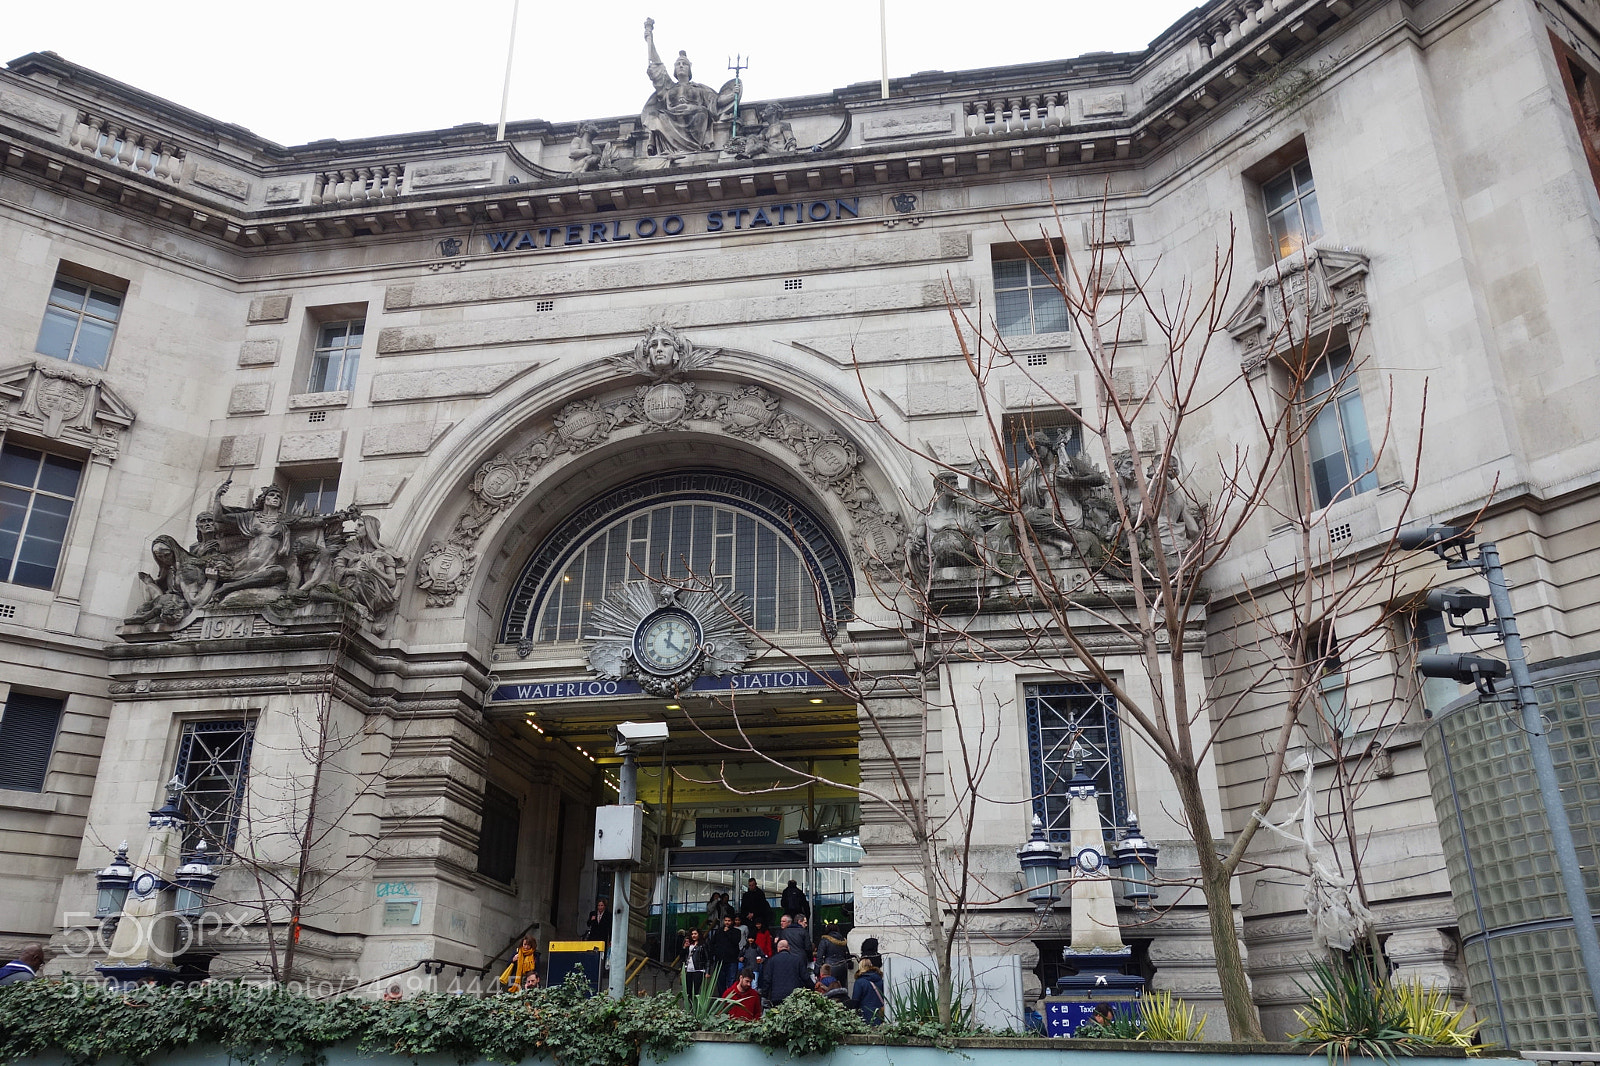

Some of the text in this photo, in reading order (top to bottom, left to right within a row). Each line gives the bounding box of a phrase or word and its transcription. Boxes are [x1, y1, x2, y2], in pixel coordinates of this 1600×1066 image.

[485, 215, 685, 253] WATERLOO
[707, 197, 860, 232] STATION
[574, 484, 644, 531] EMPLOYEES
[649, 479, 664, 495] OF
[672, 475, 697, 491] THE
[703, 475, 767, 503] COMPANY
[204, 619, 247, 639] 1914
[517, 671, 809, 699] WATERLOO STATION
[702, 829, 770, 839] Waterloo Station
[1079, 1005, 1097, 1013] Taxi
